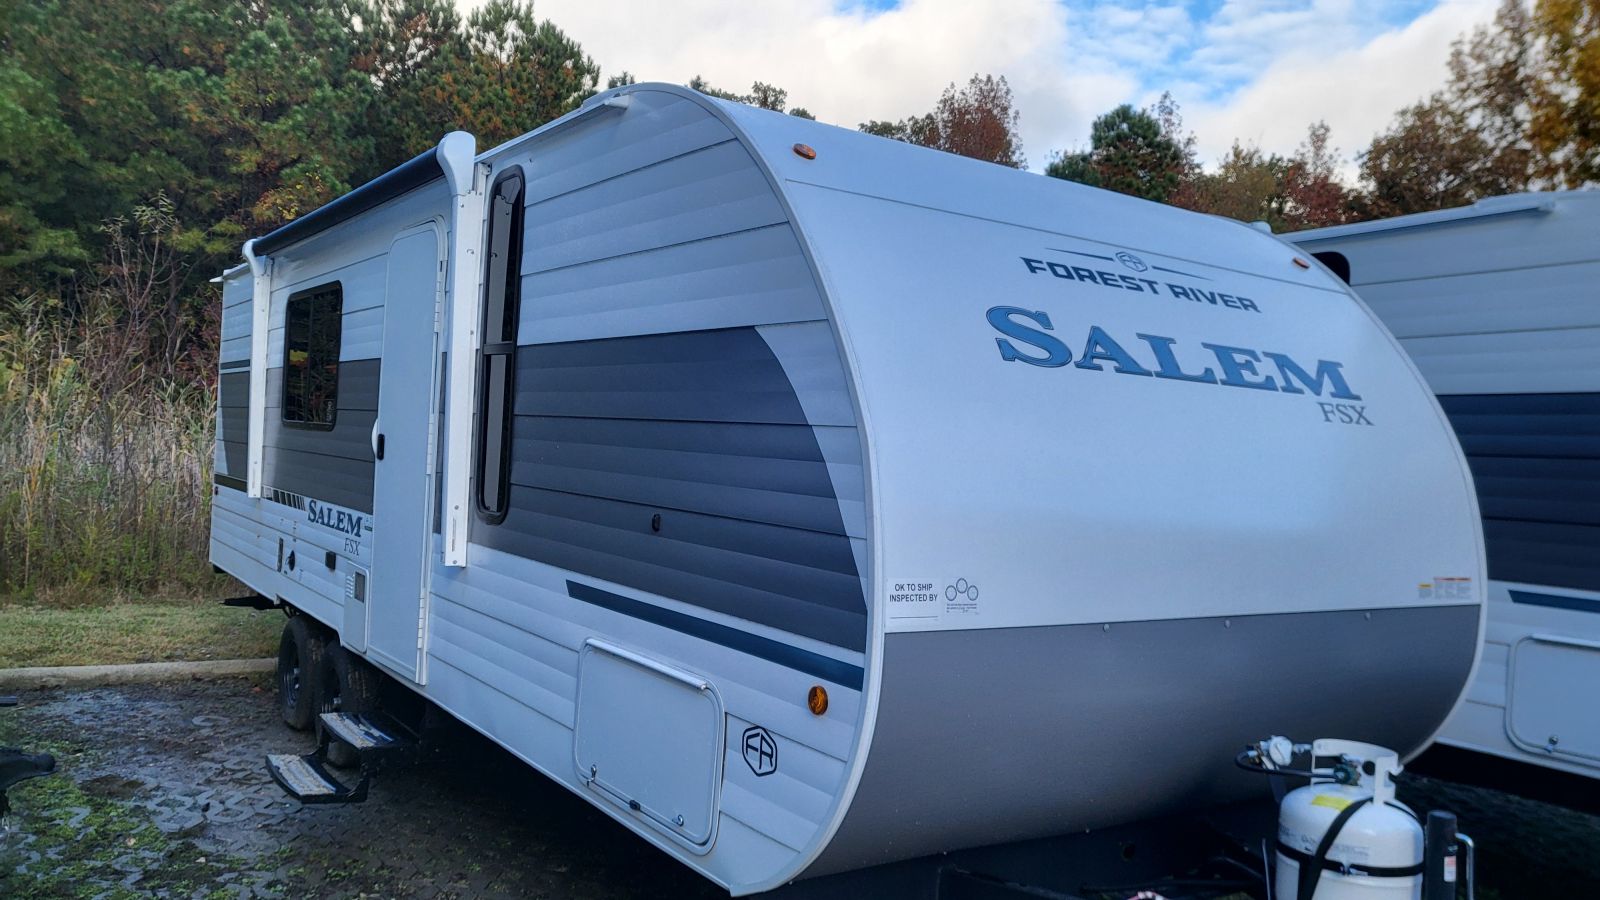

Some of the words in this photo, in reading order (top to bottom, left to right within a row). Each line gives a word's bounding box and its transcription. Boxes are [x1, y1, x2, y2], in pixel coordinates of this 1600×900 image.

[1019, 257, 1160, 295] FOREST
[1165, 283, 1262, 313] RIVER
[986, 305, 1362, 401] SALEM
[1317, 402, 1374, 427] FSX
[308, 499, 363, 537] SALEM
[344, 537, 361, 556] FSX
[889, 593, 927, 602] INSPECTED
[929, 593, 938, 602] BY
[894, 583, 905, 592] OK
[907, 583, 916, 592] TO
[917, 583, 933, 592] SHIP
